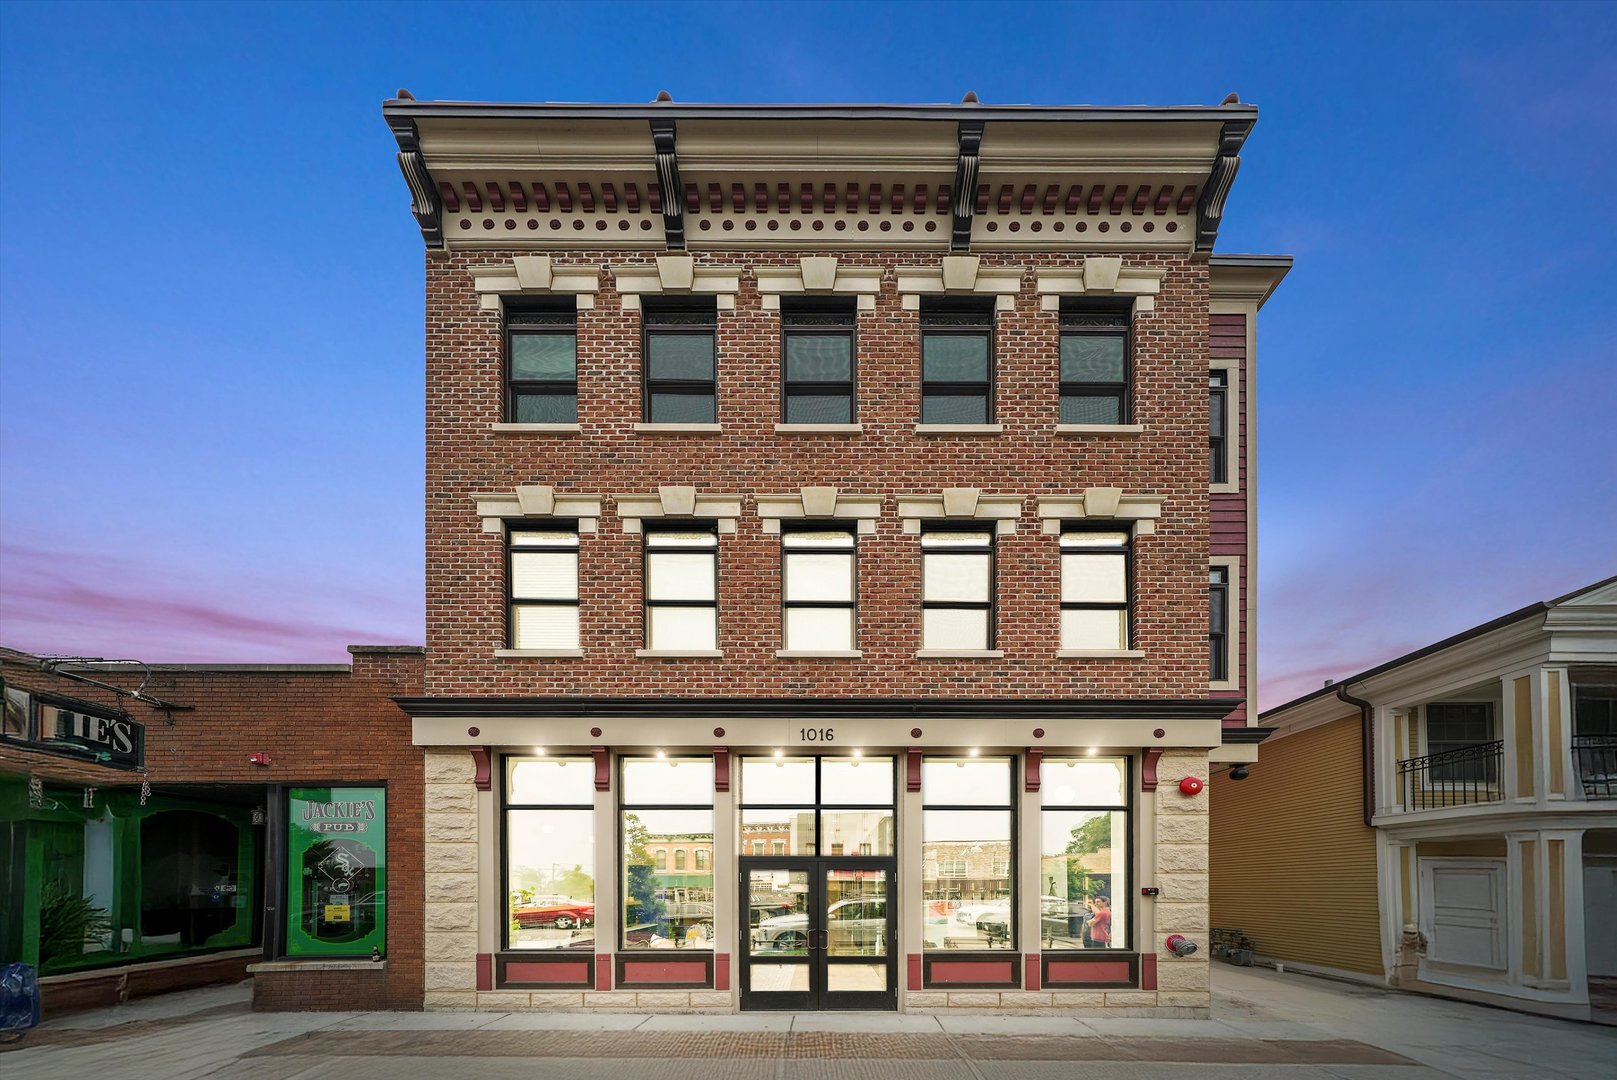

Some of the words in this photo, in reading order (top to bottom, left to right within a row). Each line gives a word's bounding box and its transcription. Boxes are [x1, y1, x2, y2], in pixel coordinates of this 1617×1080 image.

[800, 728, 834, 741] 1016
[303, 800, 375, 820] JACKIE'S
[323, 823, 355, 831] PUB
